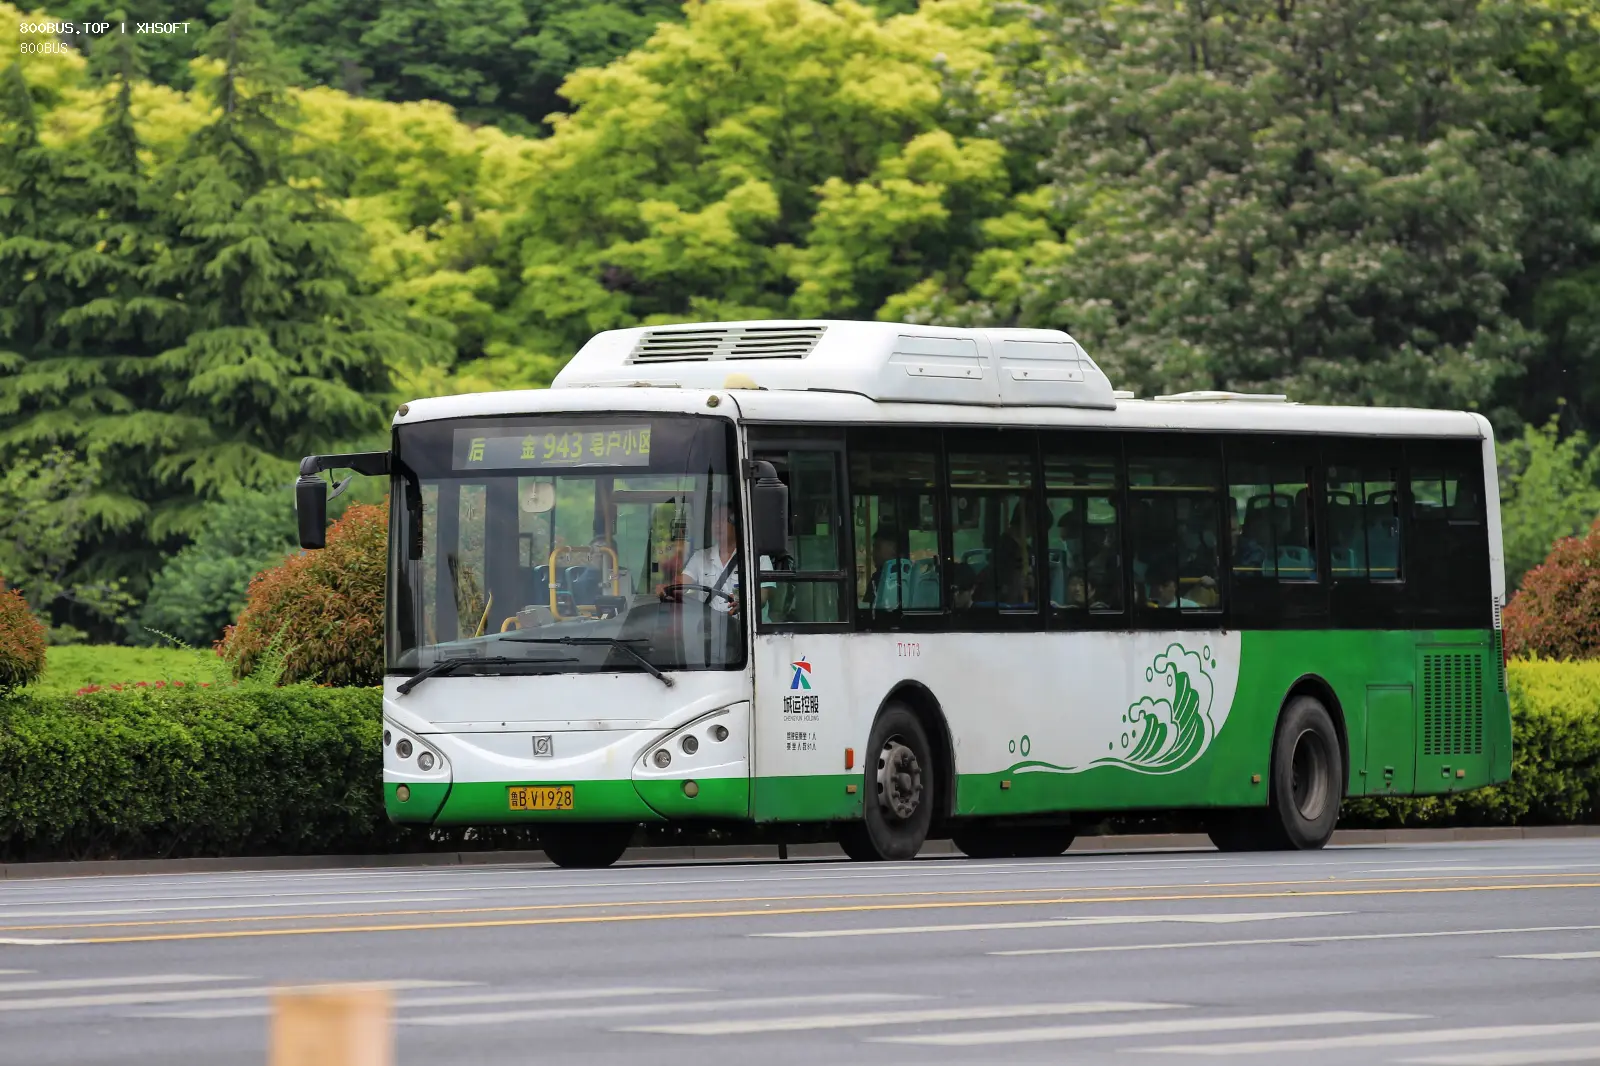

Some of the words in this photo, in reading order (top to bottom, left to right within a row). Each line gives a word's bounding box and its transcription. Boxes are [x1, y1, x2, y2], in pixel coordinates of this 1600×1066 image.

[543, 432, 584, 459] 943
[897, 642, 920, 657] T1773
[783, 695, 819, 714] 城运控股
